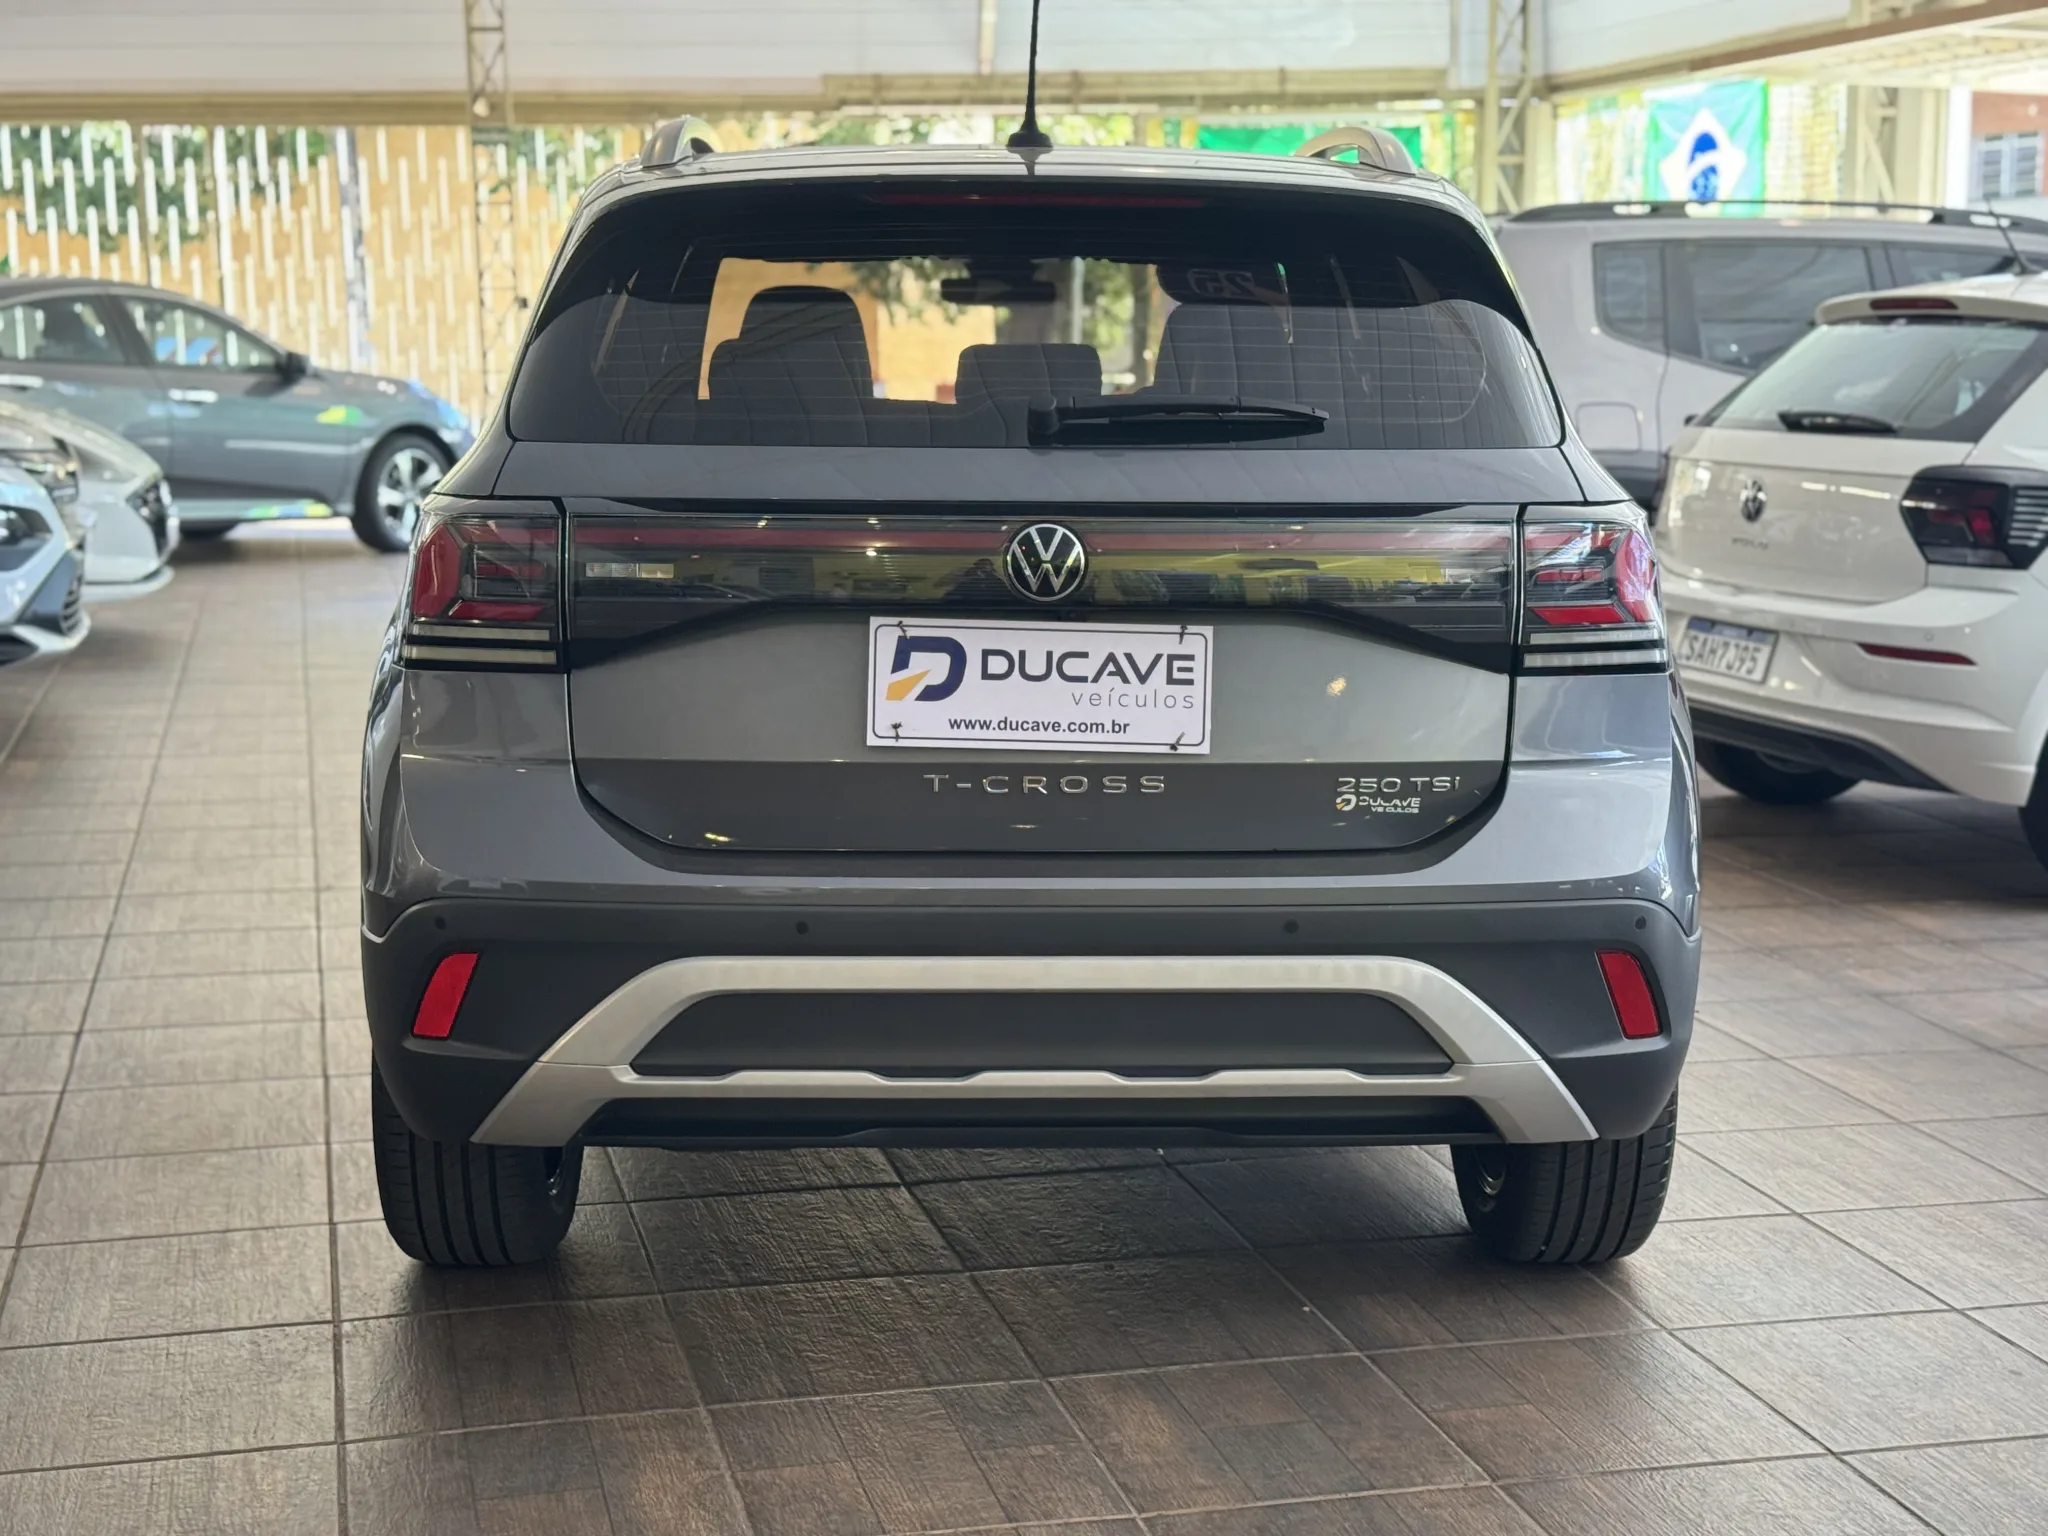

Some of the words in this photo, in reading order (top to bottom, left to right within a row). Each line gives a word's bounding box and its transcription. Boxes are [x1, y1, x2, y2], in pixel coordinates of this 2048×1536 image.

[1007, 524, 1085, 601] VW
[980, 648, 1196, 686] DUCAVE
[1071, 689, 1195, 709] veículos
[948, 716, 1131, 735] www.ducave.com.br
[922, 774, 1166, 795] T-CROSS
[1336, 777, 1401, 793] 250
